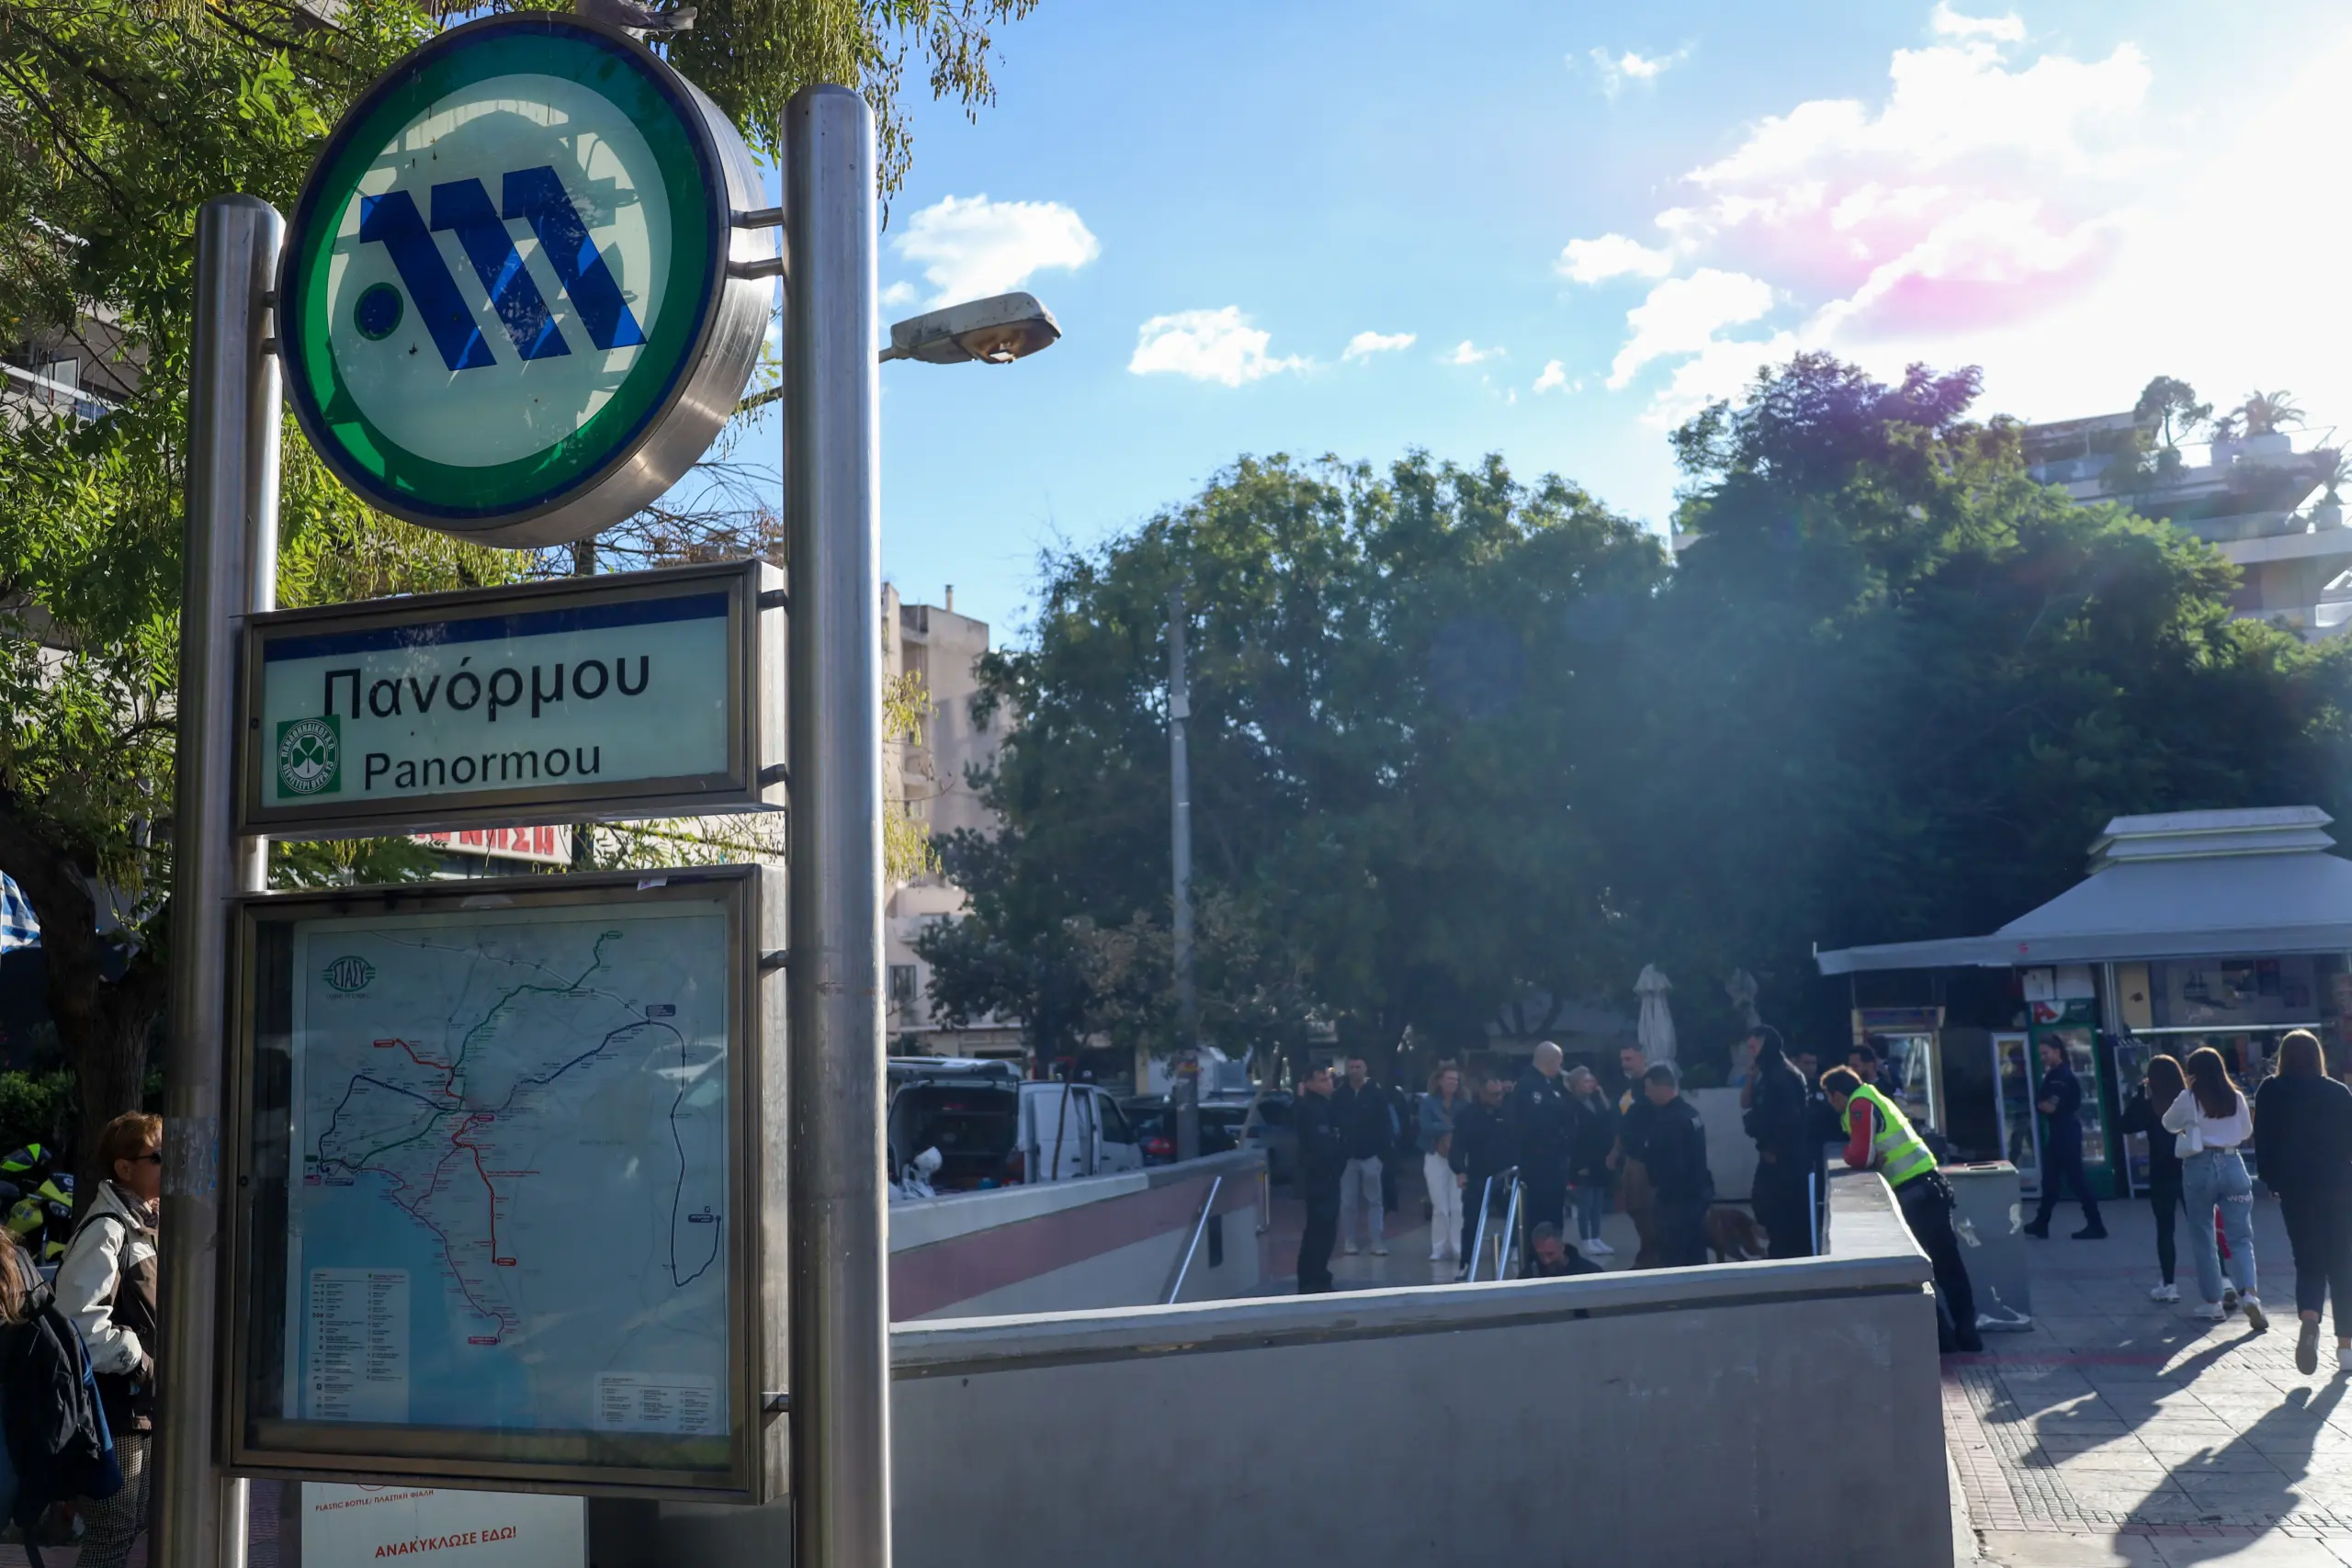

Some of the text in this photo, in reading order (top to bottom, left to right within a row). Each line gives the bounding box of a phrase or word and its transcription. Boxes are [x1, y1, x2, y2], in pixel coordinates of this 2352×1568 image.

[323, 656, 650, 723] Πανόρμου
[364, 745, 601, 791] Panormou
[315, 1501, 344, 1512] PLASTIC
[374, 1492, 409, 1504] ΠΛΑΣΤΙΚΗ
[410, 1489, 435, 1498] ΦΙΑΛΗ
[481, 1526, 517, 1542] ΕΔΩ!
